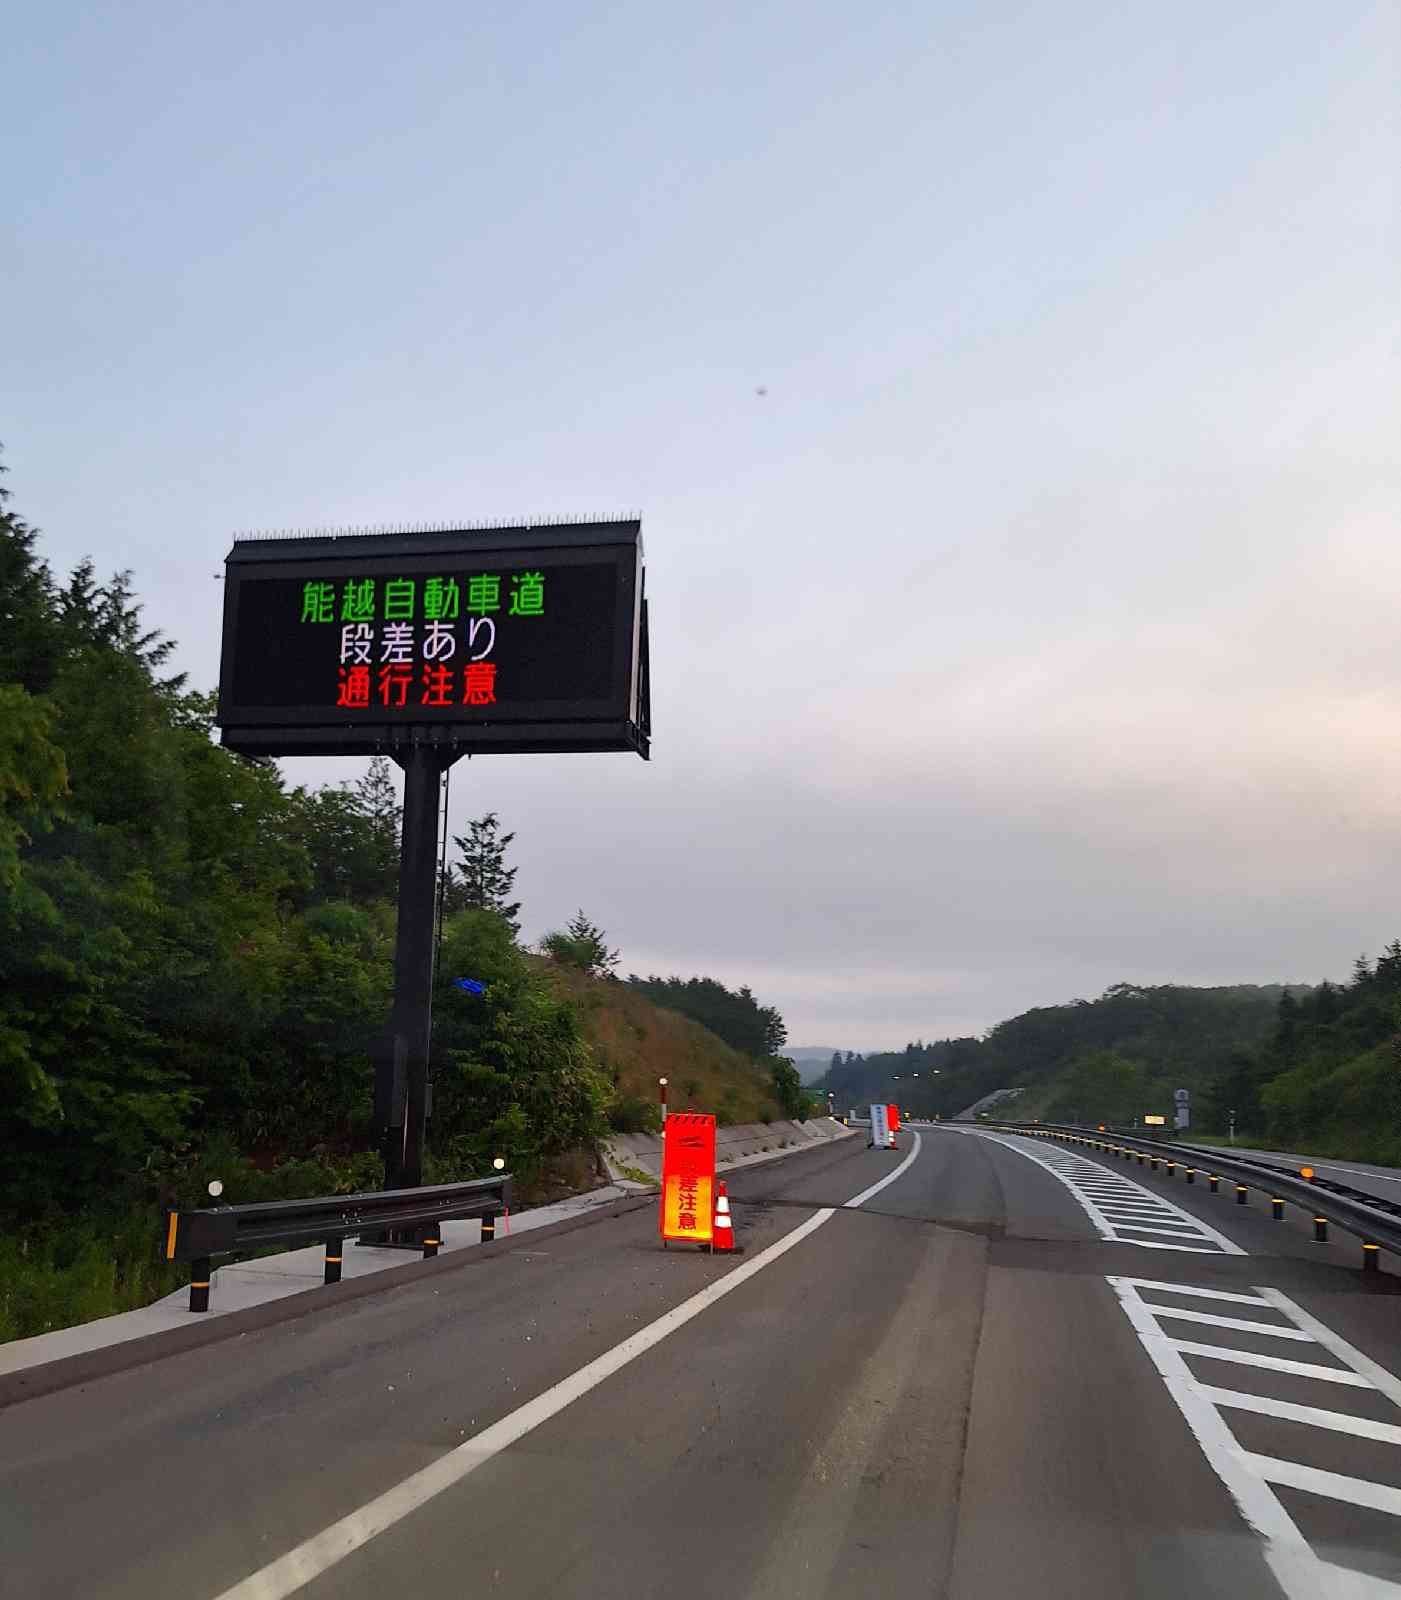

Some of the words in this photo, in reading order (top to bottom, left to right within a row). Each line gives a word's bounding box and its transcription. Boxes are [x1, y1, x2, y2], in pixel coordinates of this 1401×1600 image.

[302, 571, 545, 623] 能越自動車道
[340, 617, 496, 664] 段差あり
[337, 661, 497, 707] 通行注意
